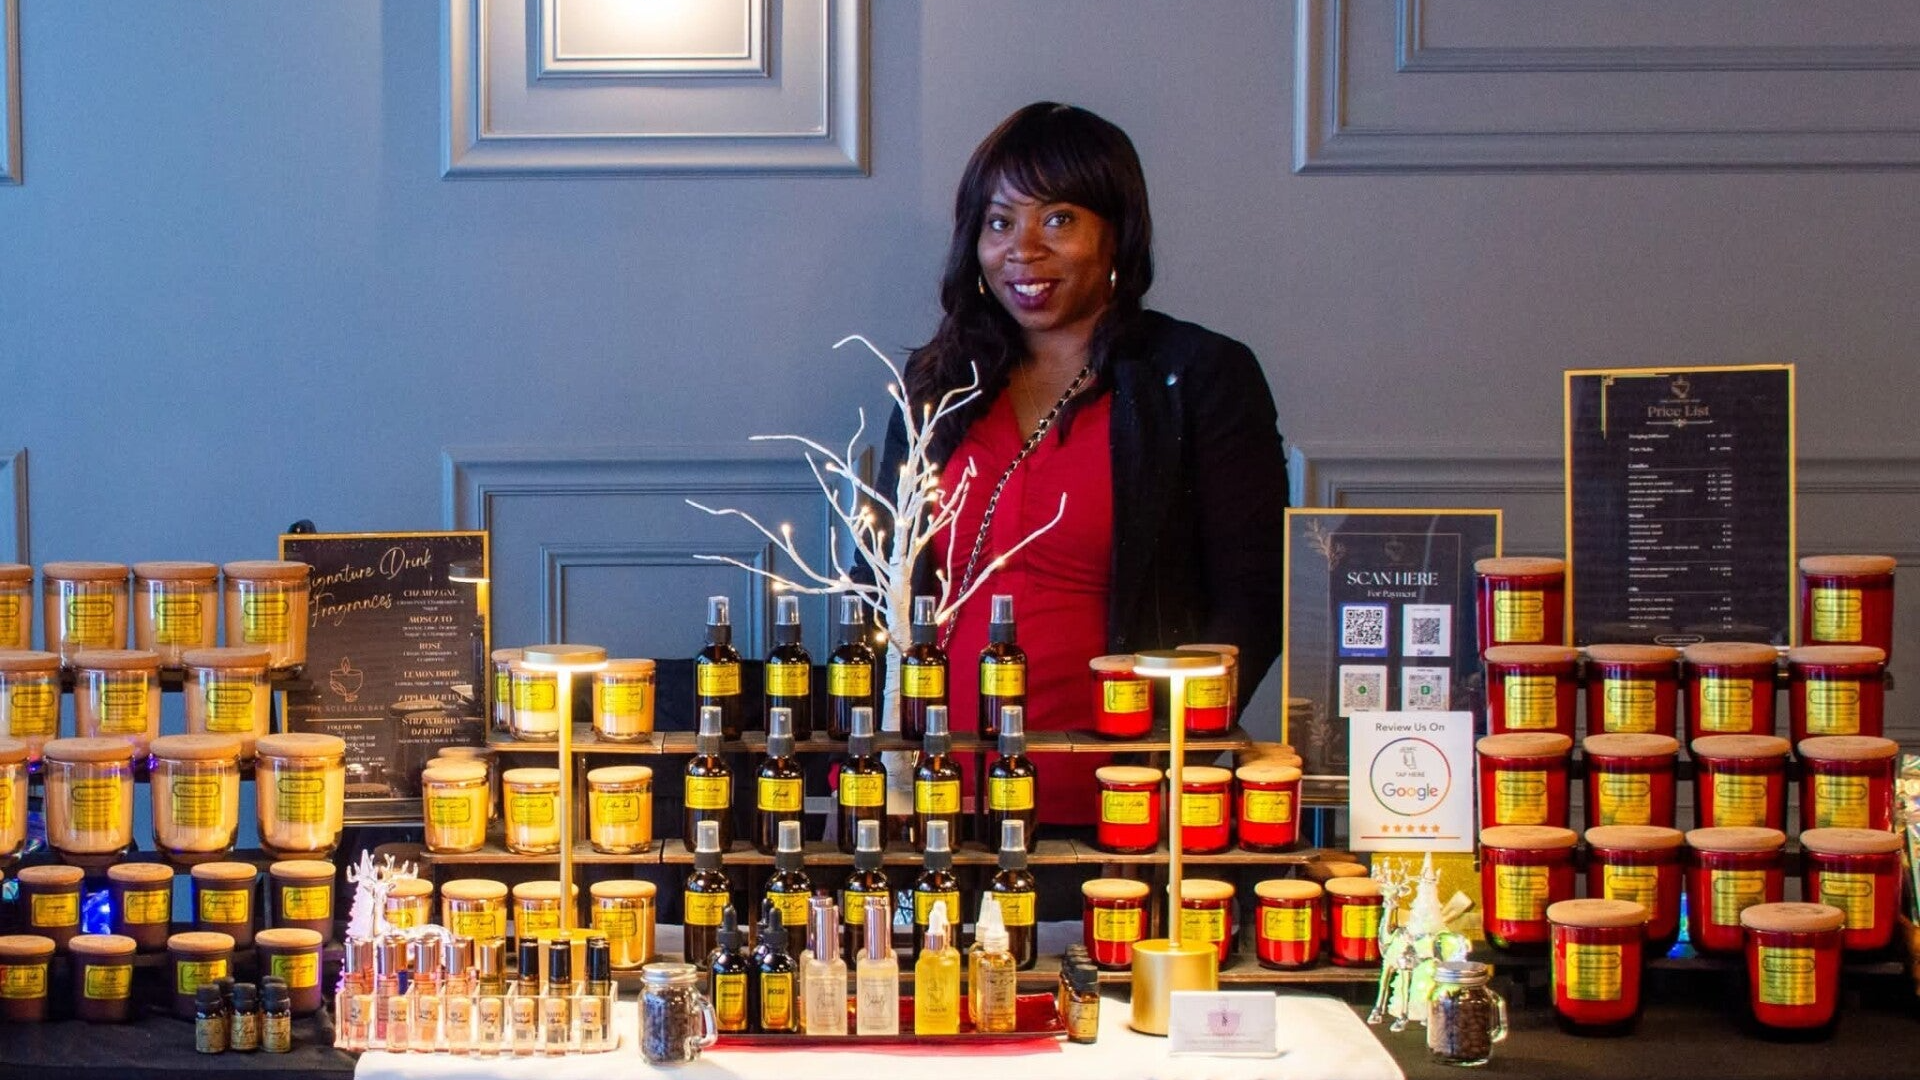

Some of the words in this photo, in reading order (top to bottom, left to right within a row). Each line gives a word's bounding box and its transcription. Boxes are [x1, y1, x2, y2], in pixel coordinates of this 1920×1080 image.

[1647, 405, 1682, 417] Price
[1685, 405, 1710, 416] List
[380, 546, 432, 580] Drink
[1346, 571, 1392, 586] SCAN
[1394, 571, 1439, 586] HERE
[403, 588, 459, 598] CHAMPAGNE
[1367, 589, 1382, 598] For
[1382, 589, 1417, 600] Payment
[309, 592, 392, 628] Fragrances
[409, 615, 453, 624] MOSCATO
[403, 670, 434, 679] LEMON
[435, 670, 460, 678] DROP
[398, 693, 424, 702] APPLE
[401, 717, 461, 726] STRAWBERRY
[1375, 722, 1412, 732] Review
[1413, 722, 1427, 732] Us
[1429, 722, 1445, 732] On
[1381, 782, 1438, 801] Google
